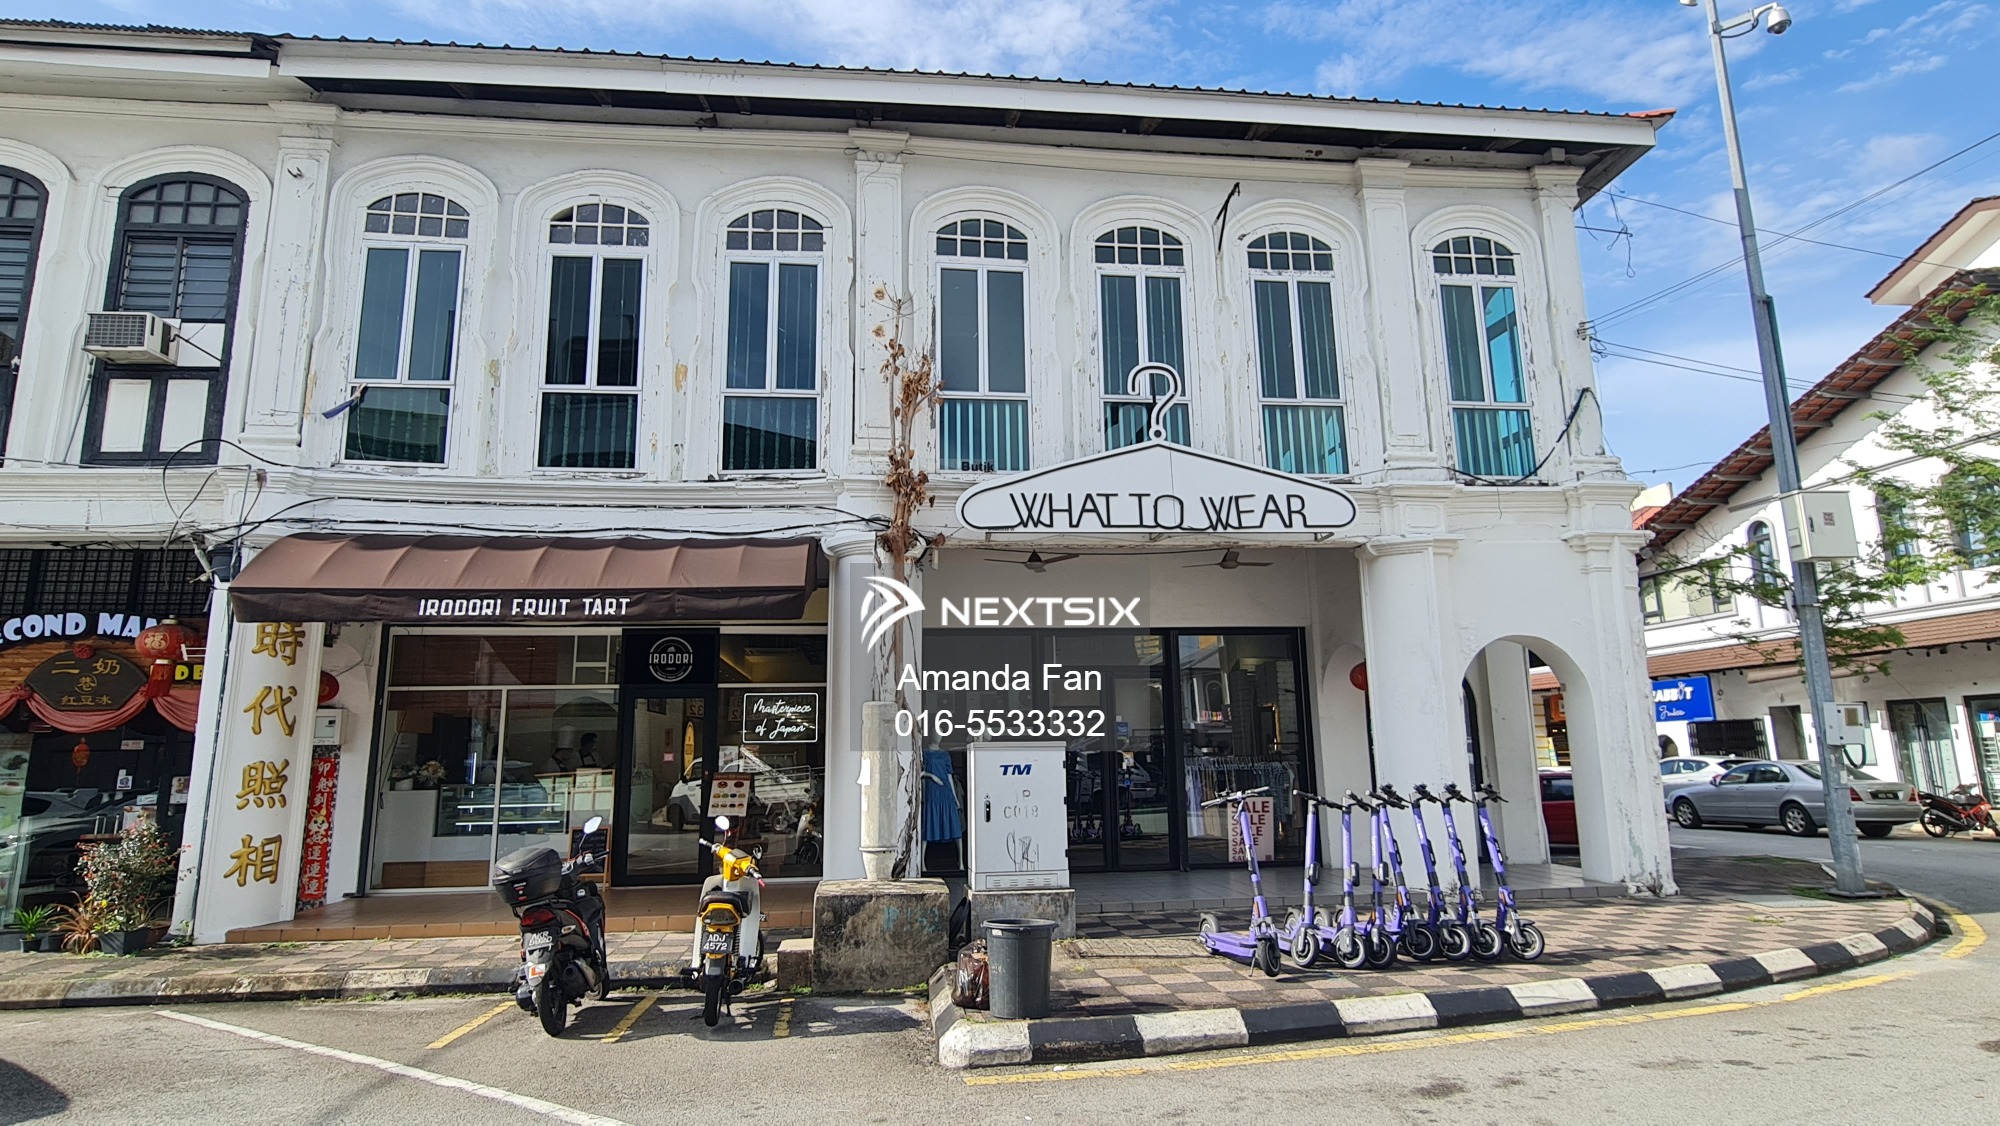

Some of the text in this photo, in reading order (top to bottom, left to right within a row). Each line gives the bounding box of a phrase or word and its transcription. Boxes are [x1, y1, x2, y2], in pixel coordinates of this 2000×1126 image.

[961, 461, 994, 472] Butik
[1009, 493, 1308, 531] WHAT TO WEAR
[418, 598, 630, 616] IRODORI FRUIT TART
[0, 612, 87, 644] COND
[649, 653, 693, 664] IRODORI
[753, 698, 812, 715] Masterpiece
[755, 718, 806, 739] of Japan
[1000, 764, 1032, 776] TM
[707, 933, 726, 942] ADJ
[703, 942, 728, 951] 4572
